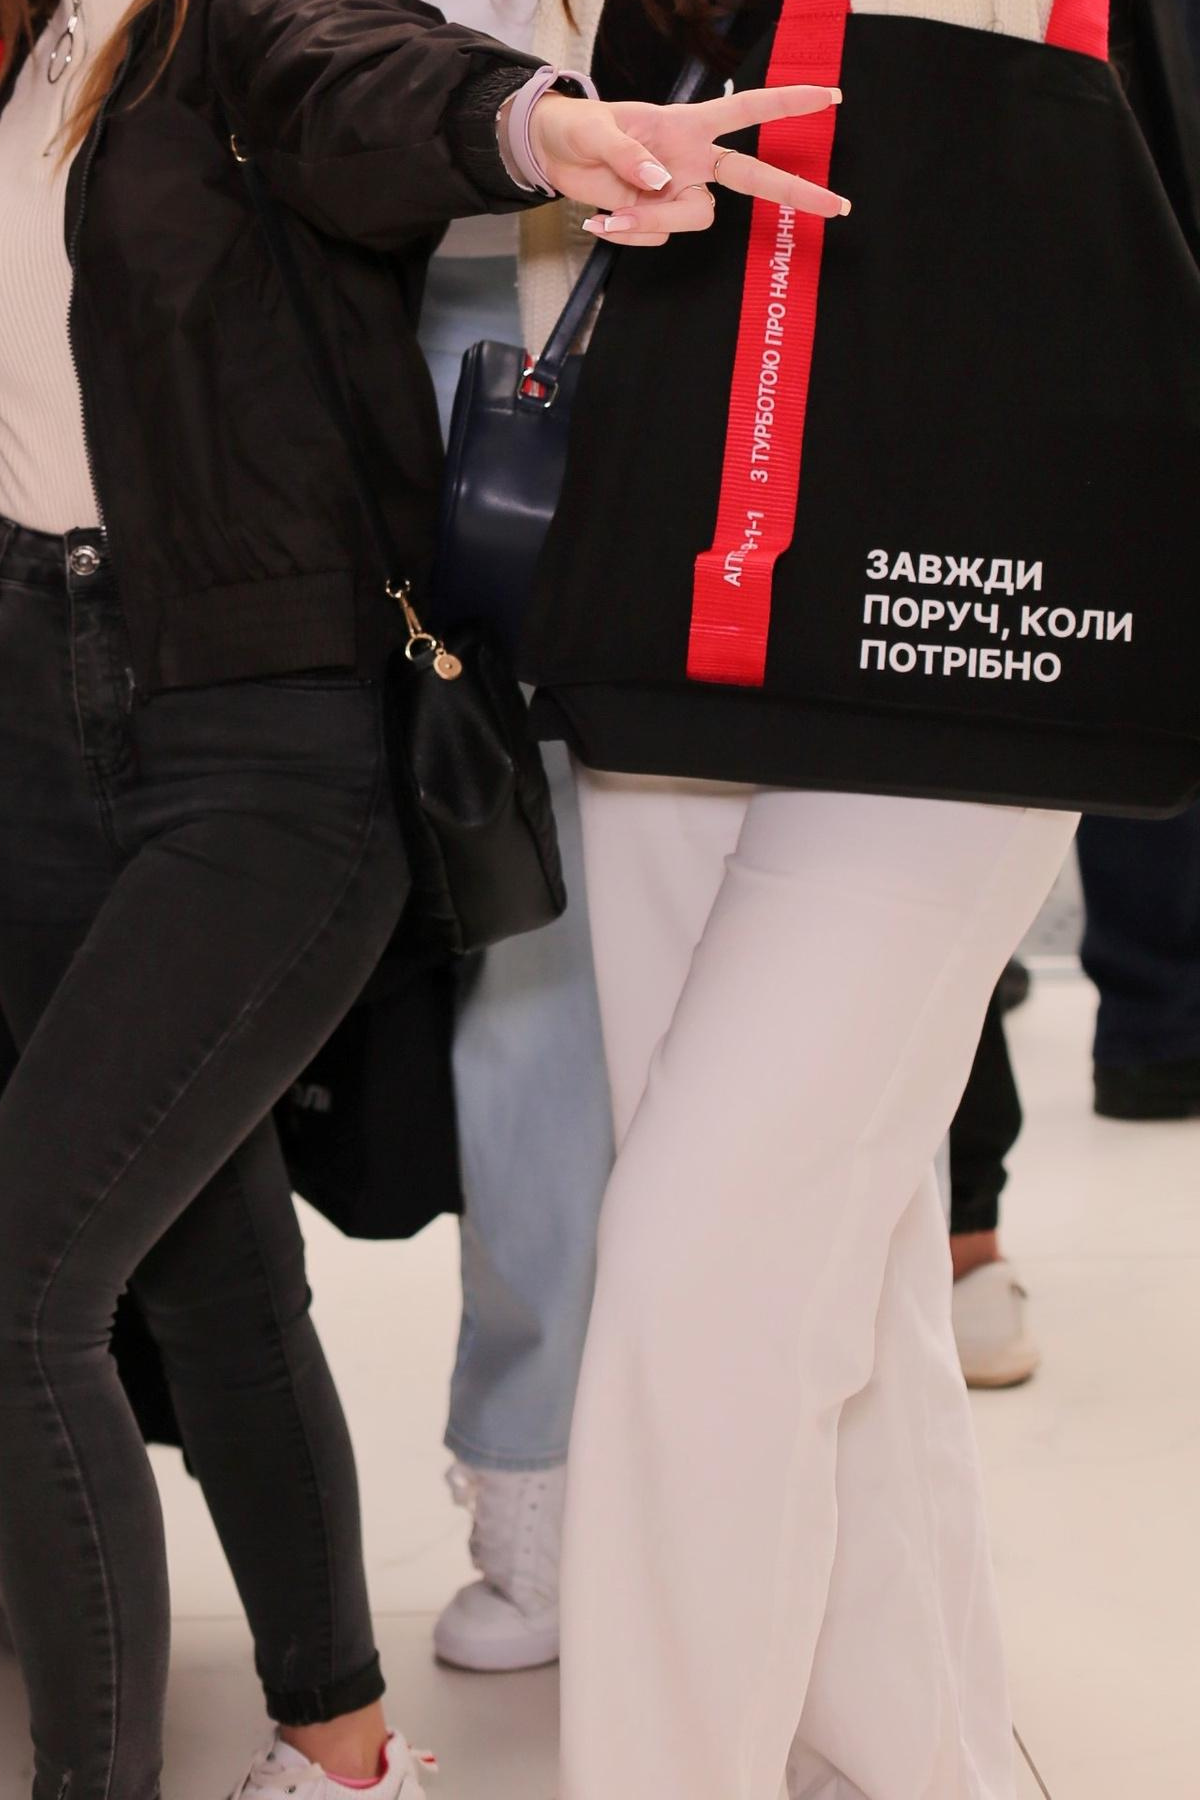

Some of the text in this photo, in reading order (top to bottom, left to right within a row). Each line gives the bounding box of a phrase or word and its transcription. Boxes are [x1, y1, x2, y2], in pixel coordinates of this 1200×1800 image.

[769, 198, 797, 298] НАЙЦІНН
[764, 303, 786, 346] ПРО
[751, 349, 781, 463] ТУРБОТОЮ
[750, 469, 768, 483] З
[865, 549, 1043, 596] ЗАВЖДИ
[863, 594, 1133, 642] ПОРУЧ, КОЛИ
[859, 639, 1062, 683] ПОТРІБНО
